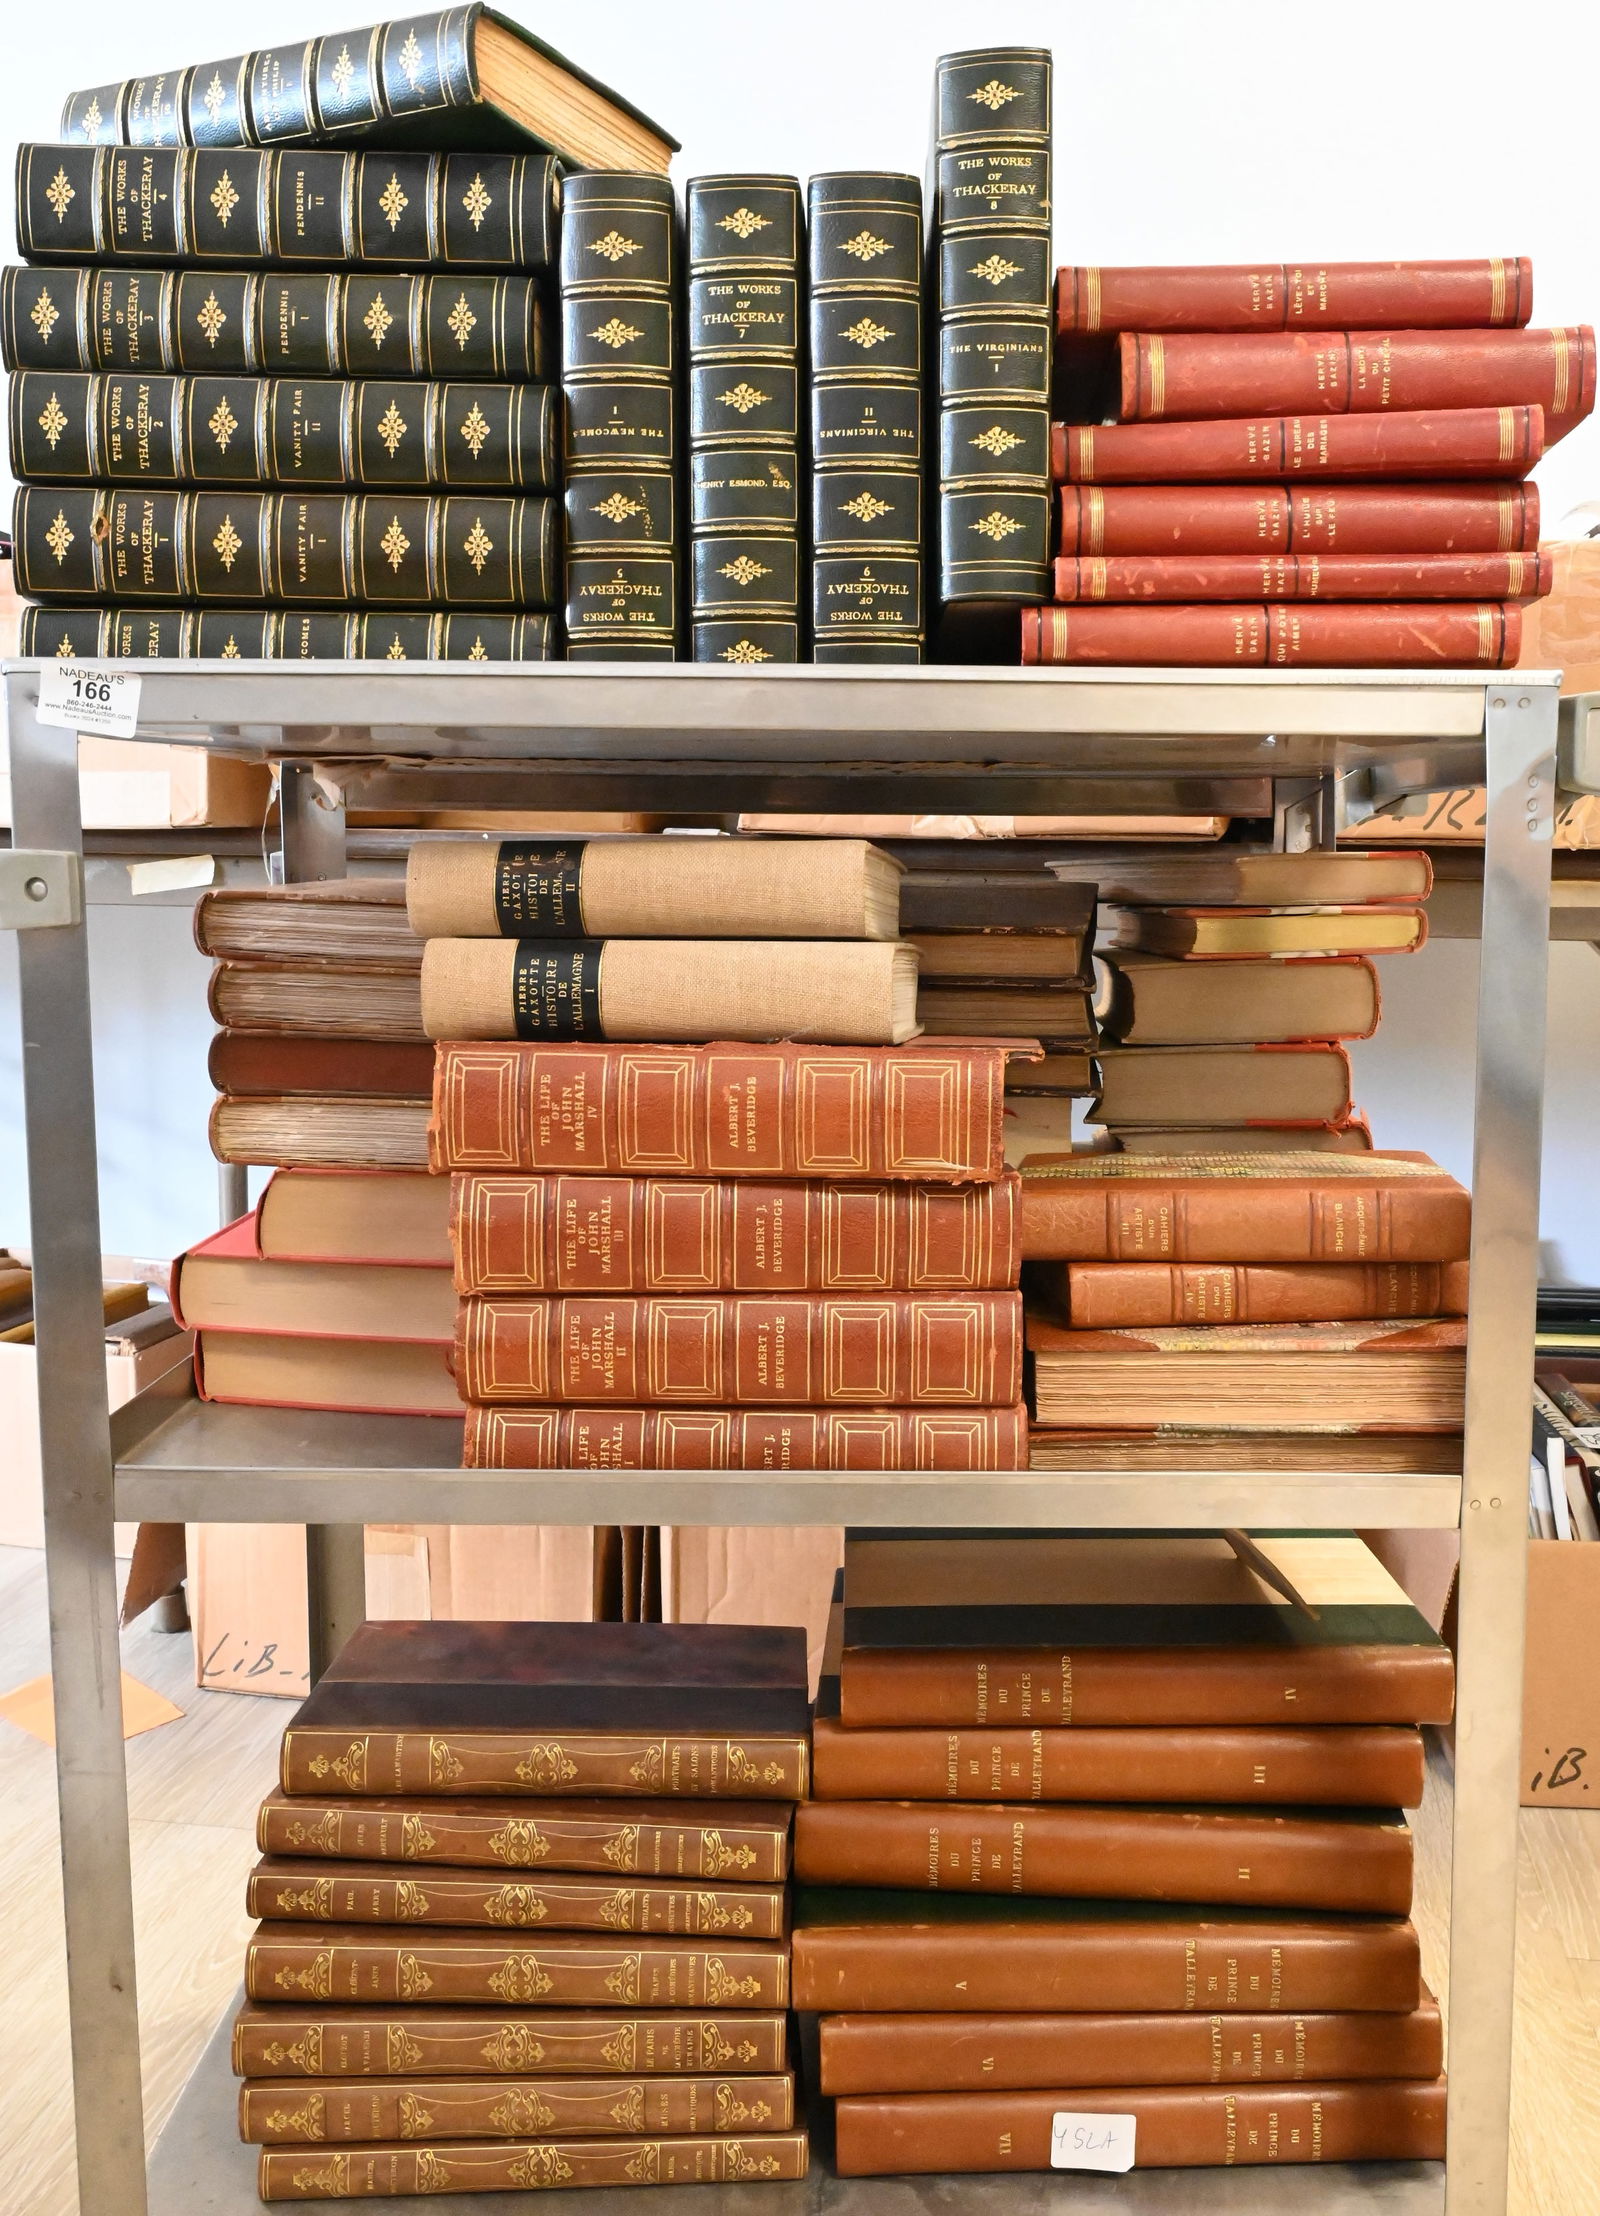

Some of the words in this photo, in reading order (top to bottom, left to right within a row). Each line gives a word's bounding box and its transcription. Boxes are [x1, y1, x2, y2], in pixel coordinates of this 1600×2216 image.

[958, 158, 984, 170] THE
[988, 156, 1032, 166] WORKS
[116, 158, 127, 202] WORKS
[988, 172, 1002, 180] OF
[130, 188, 139, 203] OF
[140, 156, 154, 242] THACKERAY
[952, 184, 1036, 198] THACKERAY
[296, 170, 305, 236] PENDENNIS
[117, 206, 128, 236] THE
[708, 286, 734, 296] THE
[738, 284, 782, 294] WORKS
[1308, 283, 1315, 296] ET
[102, 280, 113, 323] WORKS
[736, 300, 750, 308] OF
[116, 310, 124, 325] OF
[126, 277, 141, 363] THACKERAY
[280, 289, 289, 355] PENDENNIS
[702, 312, 785, 326] THACKERAY
[102, 327, 113, 356] THE
[949, 344, 971, 354] THE
[976, 344, 1043, 353] VIRGINIANS
[1358, 376, 1366, 389] LA
[1382, 377, 1390, 404] PETIT
[112, 386, 122, 430] WORKS
[294, 388, 304, 415] FAIR
[126, 415, 134, 430] OF
[138, 384, 150, 470] THACKERAY
[573, 428, 635, 438] NEWCOMES
[640, 429, 664, 438] THE
[820, 428, 887, 438] VIRGINIANS
[892, 428, 914, 438] THE
[1293, 418, 1302, 453] BUREAU
[1307, 432, 1315, 450] DES
[112, 433, 122, 462] THE
[294, 420, 302, 468] VANITY
[1293, 456, 1302, 469] LE
[696, 480, 724, 489] HENRY
[772, 480, 792, 489] ESQ.
[116, 502, 127, 546] WORKS
[298, 504, 308, 531] FAIR
[1328, 523, 1336, 536] LE
[130, 532, 140, 547] OF
[142, 500, 154, 585] THACKERAY
[117, 550, 128, 578] THE
[580, 585, 662, 596] THACKERAY
[826, 584, 909, 595] THACKERAY
[612, 598, 626, 606] OF
[859, 597, 873, 605] OF
[582, 612, 624, 622] WORKS
[629, 612, 656, 622] THE
[830, 612, 872, 621] WORKS
[877, 611, 902, 621] THE
[1278, 642, 1286, 662] QUI
[60, 666, 125, 685] NADEAU'S
[72, 680, 111, 702] 166
[45, 702, 132, 720] www.NadeausAuction.com
[66, 699, 112, 712] 860-246-2444
[540, 880, 548, 895] DE
[566, 884, 576, 892] II
[518, 968, 528, 1014] PIERRE
[529, 958, 540, 1026] GAXOTTE
[546, 959, 558, 1027] HISTOIRE
[558, 982, 568, 998] DE
[571, 952, 584, 1031] L'ALLEMAGNE
[541, 1073, 551, 1110] LIFE
[730, 1082, 741, 1092] J.
[552, 1102, 560, 1120] OF
[561, 1086, 575, 1132] JOHN
[574, 1072, 586, 1152] MARSHALL
[586, 1106, 598, 1119] IV
[747, 1076, 757, 1152] BEVERIDGE
[541, 1116, 551, 1146] THE
[729, 1096, 739, 1148] ALBERT
[566, 1198, 577, 1234] LIFE
[756, 1204, 768, 1214] J.
[578, 1227, 586, 1245] OF
[588, 1211, 600, 1256] JOHN
[601, 1195, 612, 1274] MARSHALL
[614, 1230, 624, 1242] III
[773, 1198, 784, 1273] BEVERIDGE
[1122, 1222, 1130, 1236] III
[1134, 1208, 1144, 1250] ARTISTE
[1160, 1206, 1168, 1252] CAHIERS
[1335, 1203, 1344, 1253] BLANCHE
[756, 1218, 766, 1270] ALBERT
[566, 1240, 577, 1270] THE
[1198, 1276, 1206, 1318] ARTISTE
[1223, 1273, 1232, 1318] CAHIERS
[570, 1314, 581, 1350] LIFE
[759, 1322, 771, 1332] J.
[582, 1342, 590, 1361] OF
[591, 1326, 604, 1371] JOHN
[604, 1312, 616, 1390] MARSHALL
[616, 1345, 626, 1357] II
[776, 1316, 786, 1390] BEVERIDGE
[758, 1335, 768, 1386] ALBERT
[570, 1356, 580, 1385] THE
[579, 1425, 590, 1460] LIFE
[998, 1688, 1008, 1704] DU
[1022, 1672, 1031, 1718] PRINCE
[1042, 1688, 1051, 1703] DE
[946, 1735, 958, 1796] MÉMOIRES
[970, 1760, 980, 1775] DU
[992, 1746, 1002, 1791] PRINCE
[1011, 1762, 1020, 1777] DE
[950, 1852, 960, 1867] DU
[972, 1838, 982, 1882] PRINCE
[992, 1854, 1002, 1869] DE
[1208, 1976, 1218, 1992] DE
[1227, 1958, 1238, 2004] PRINCE
[1250, 1976, 1260, 1991] DU
[1232, 2051, 1242, 2066] DE
[1252, 2032, 1262, 2078] PRINCE
[1275, 2049, 1284, 2064] DU
[1248, 2130, 1258, 2145] DE
[1268, 2112, 1278, 2158] PRINCE
[1290, 2128, 1300, 2144] DU
